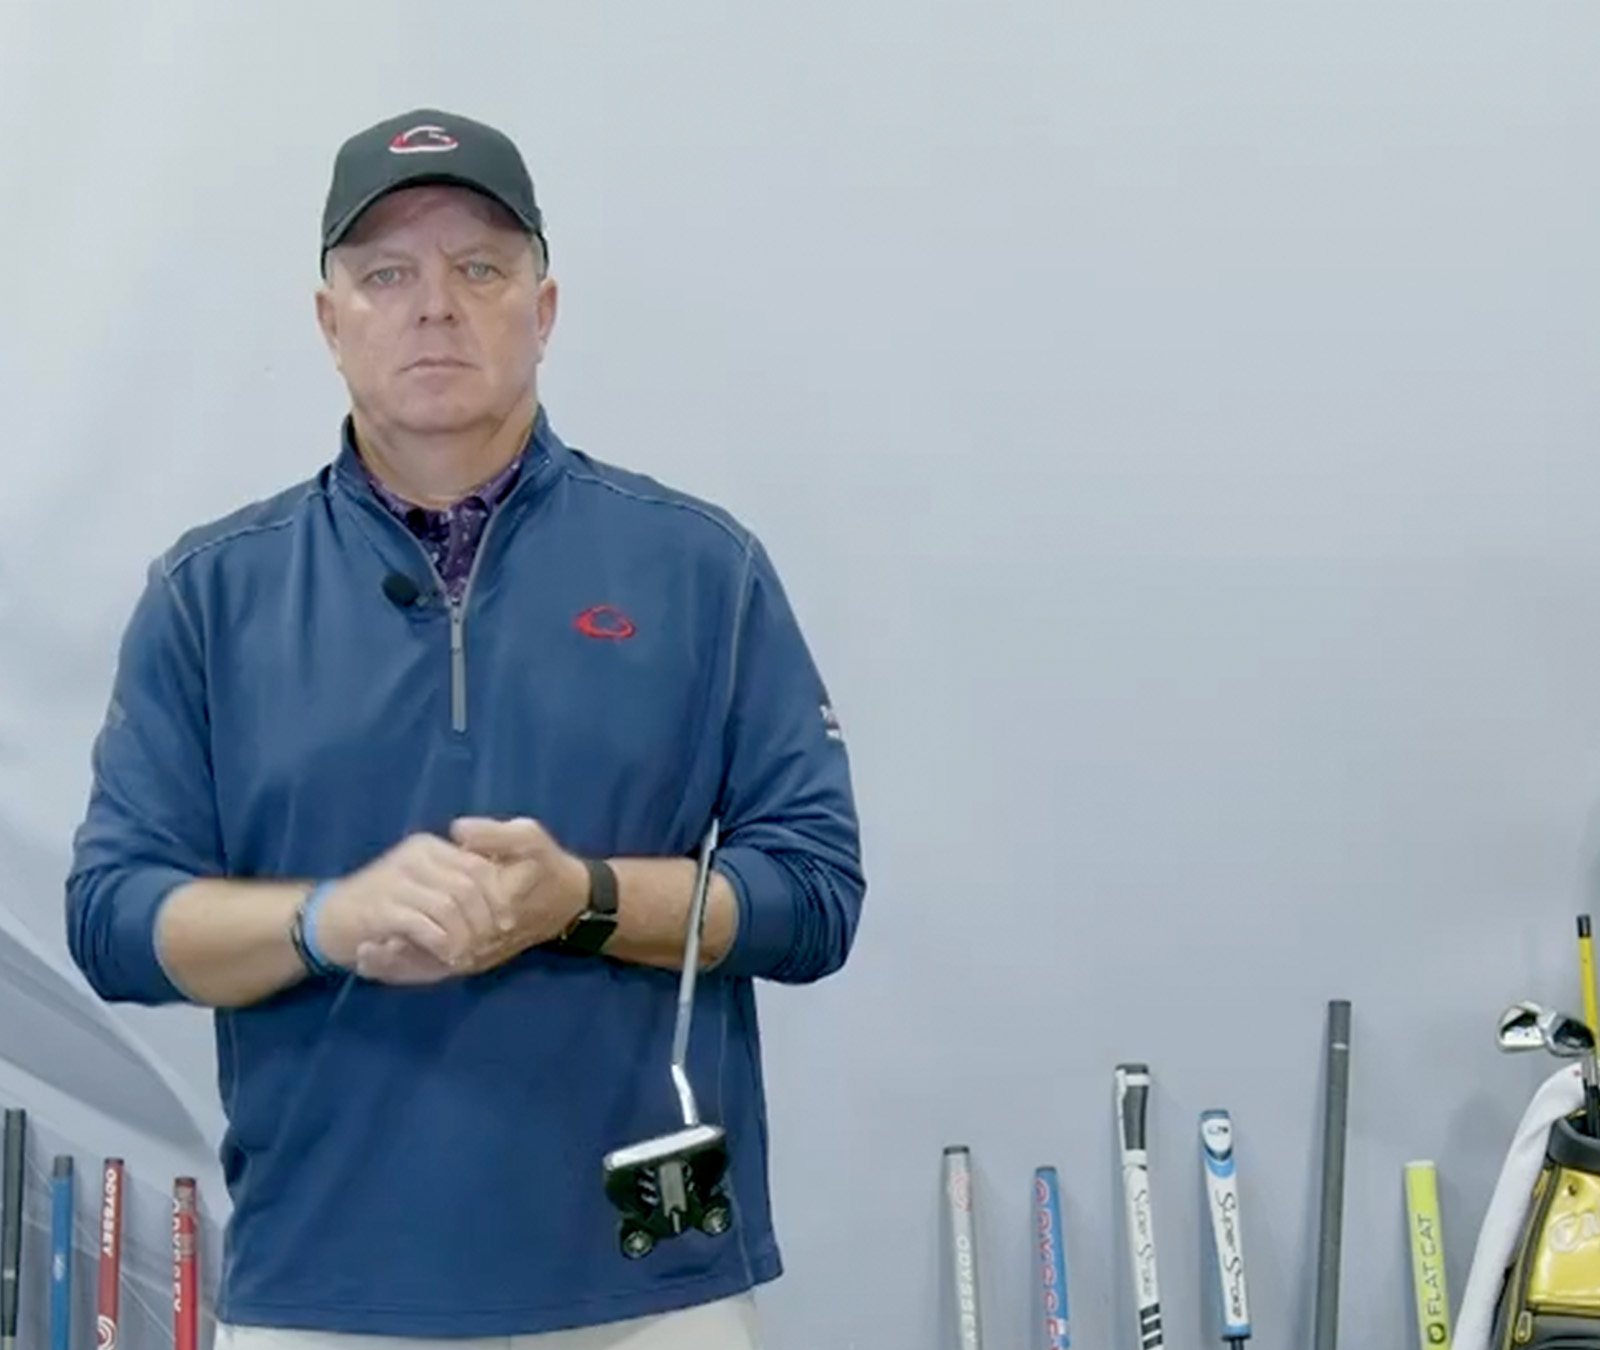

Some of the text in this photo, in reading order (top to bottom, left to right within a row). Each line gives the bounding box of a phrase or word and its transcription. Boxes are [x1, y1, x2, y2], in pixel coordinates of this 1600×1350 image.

[103, 1168, 118, 1259] ODYSSEY
[1417, 1213, 1442, 1317] FLAT CAT
[956, 1234, 977, 1345] ODYSSEY
